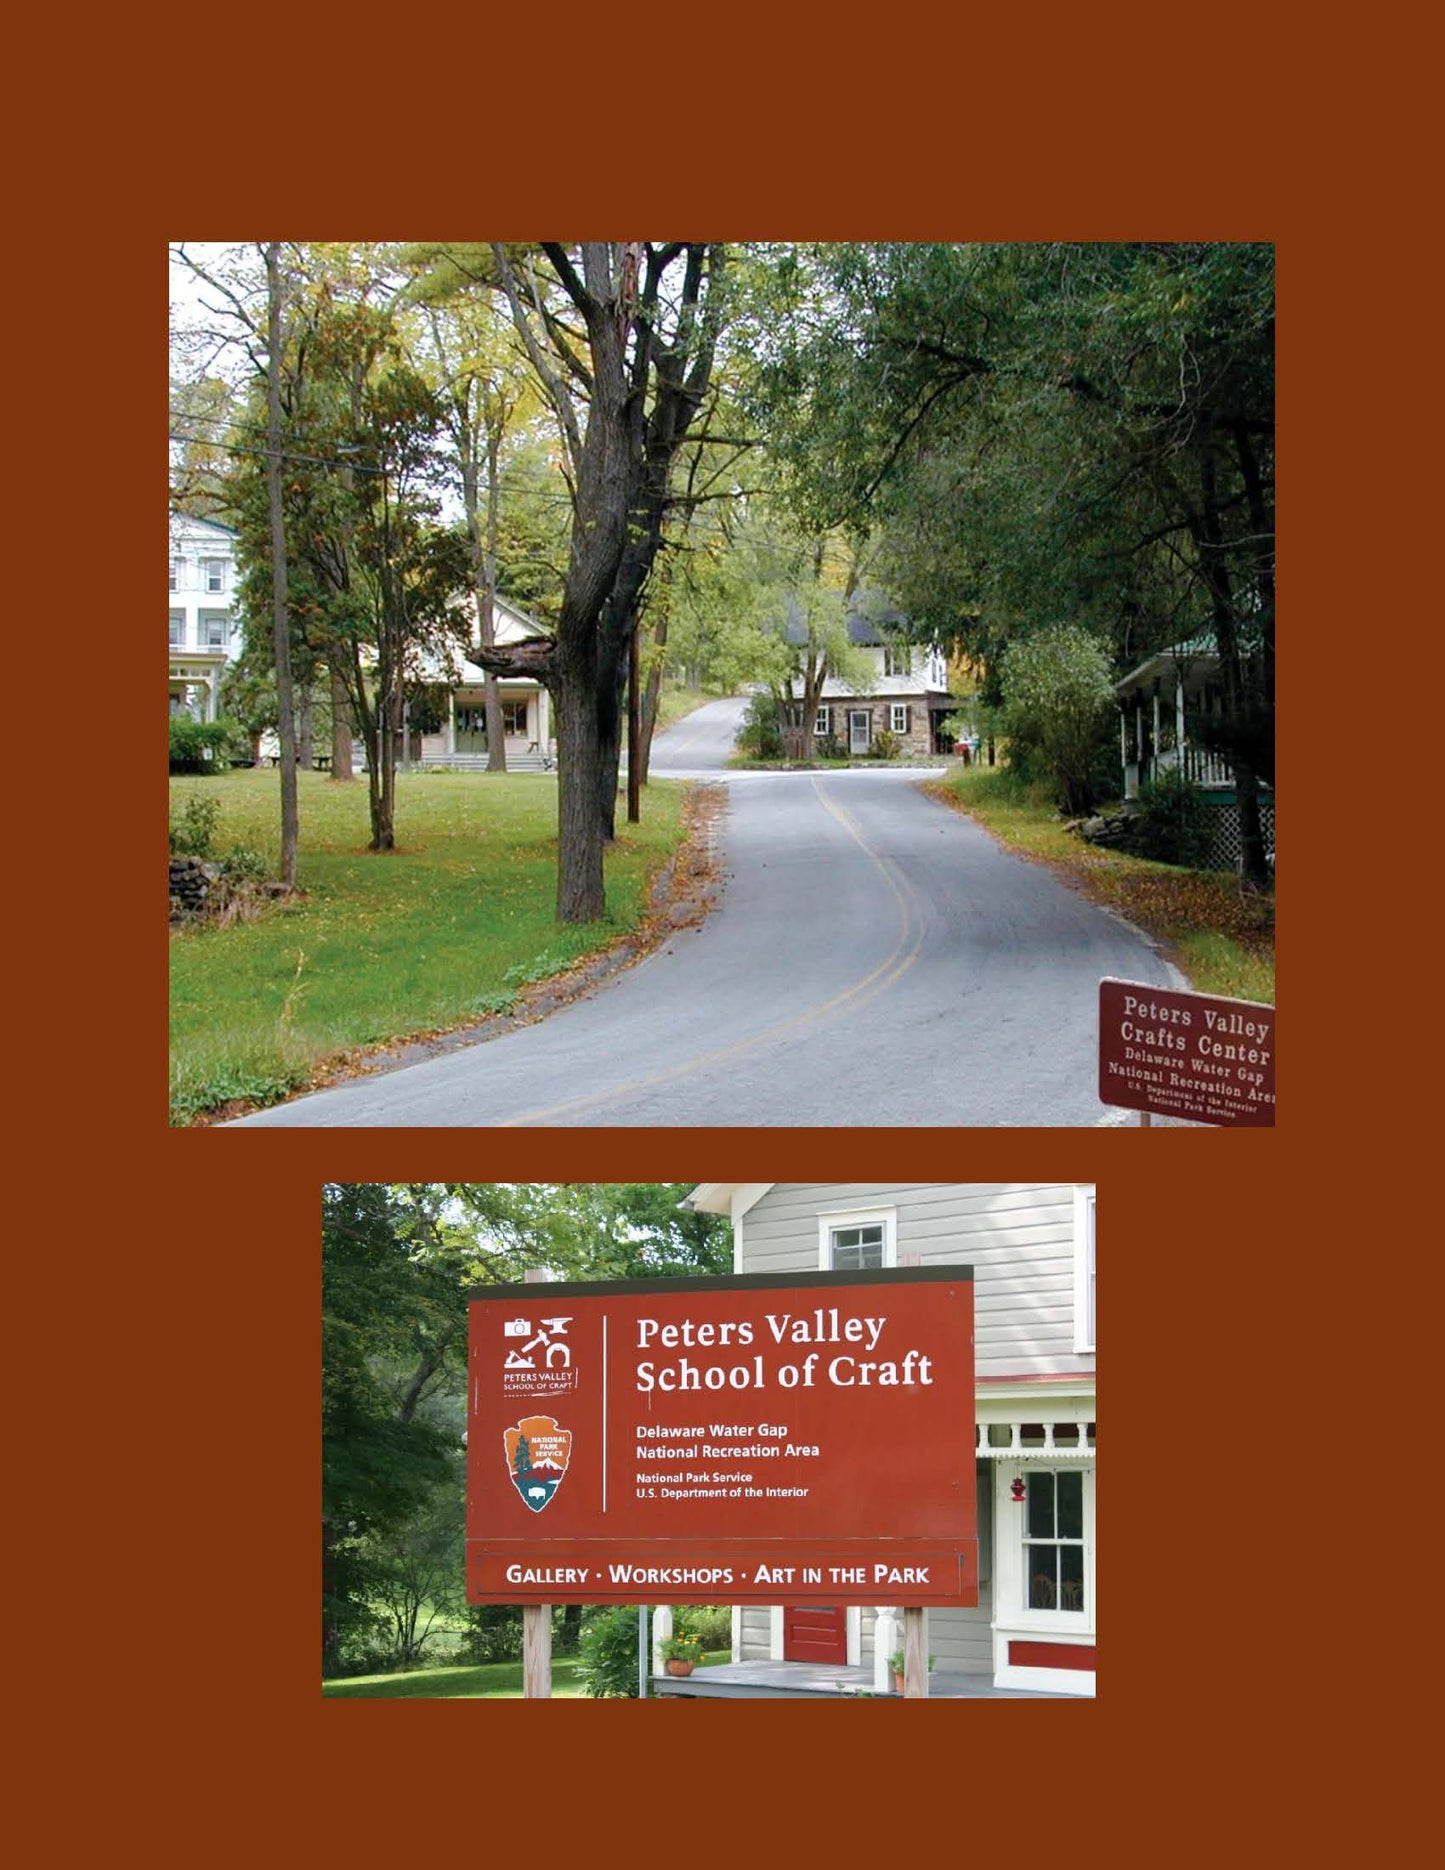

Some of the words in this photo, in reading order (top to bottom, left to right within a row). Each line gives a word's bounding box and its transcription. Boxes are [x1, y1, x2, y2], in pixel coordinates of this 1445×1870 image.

[1124, 996, 1192, 1026] Peters
[1204, 1010, 1270, 1044] Valley
[1121, 1022, 1186, 1051] Crafts
[1198, 1036, 1270, 1065] Center
[1108, 1062, 1163, 1082] National
[1170, 1073, 1241, 1097] Recreation
[1125, 1047, 1185, 1069] Delaware
[1191, 1059, 1231, 1077] Water
[1237, 1067, 1264, 1086] Gap
[637, 1319, 754, 1348] Peters
[765, 1309, 886, 1350] Valley
[504, 1374, 537, 1382] PETERS
[539, 1373, 572, 1381] VALLEY
[637, 1356, 765, 1391] School
[778, 1353, 819, 1387] of
[828, 1351, 933, 1386] Craft
[637, 1425, 705, 1439] Delaware
[708, 1424, 754, 1438] Water
[758, 1424, 788, 1441] Gap
[637, 1445, 698, 1459] National
[702, 1444, 780, 1458] Recreation
[784, 1444, 819, 1457] Area
[637, 1473, 682, 1483] National
[686, 1472, 709, 1482] Park
[713, 1472, 753, 1483] Service
[637, 1488, 657, 1498] U.S.
[661, 1487, 726, 1500] Department
[729, 1487, 741, 1497] of
[743, 1487, 763, 1497] the
[766, 1486, 808, 1497] Interior
[506, 1564, 588, 1584] GALLERY
[608, 1564, 733, 1584] WORKSHOPS
[754, 1564, 795, 1584] ART
[803, 1568, 821, 1584] IN
[829, 1568, 867, 1584] THE
[874, 1564, 929, 1584] PARK
